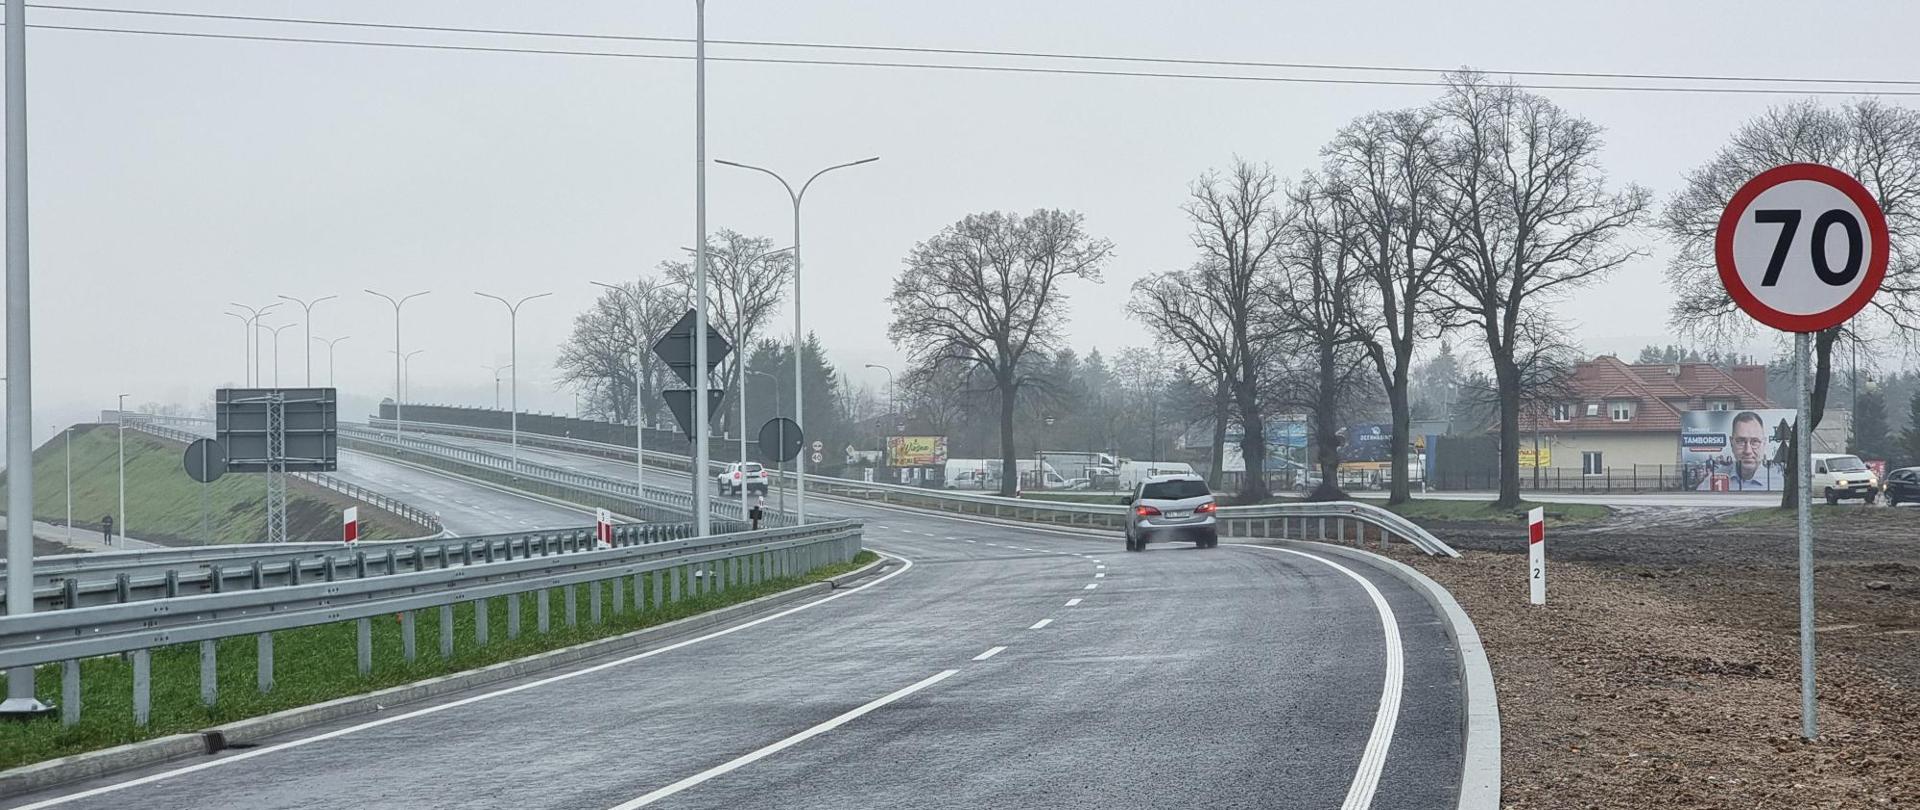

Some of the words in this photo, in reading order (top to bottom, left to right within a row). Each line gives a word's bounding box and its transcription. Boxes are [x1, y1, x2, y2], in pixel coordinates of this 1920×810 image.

[1754, 208, 1863, 287] 70
[1683, 436, 1724, 444] TAMBORSKI
[1714, 479, 1722, 491] 1
[1533, 567, 1541, 579] 2
